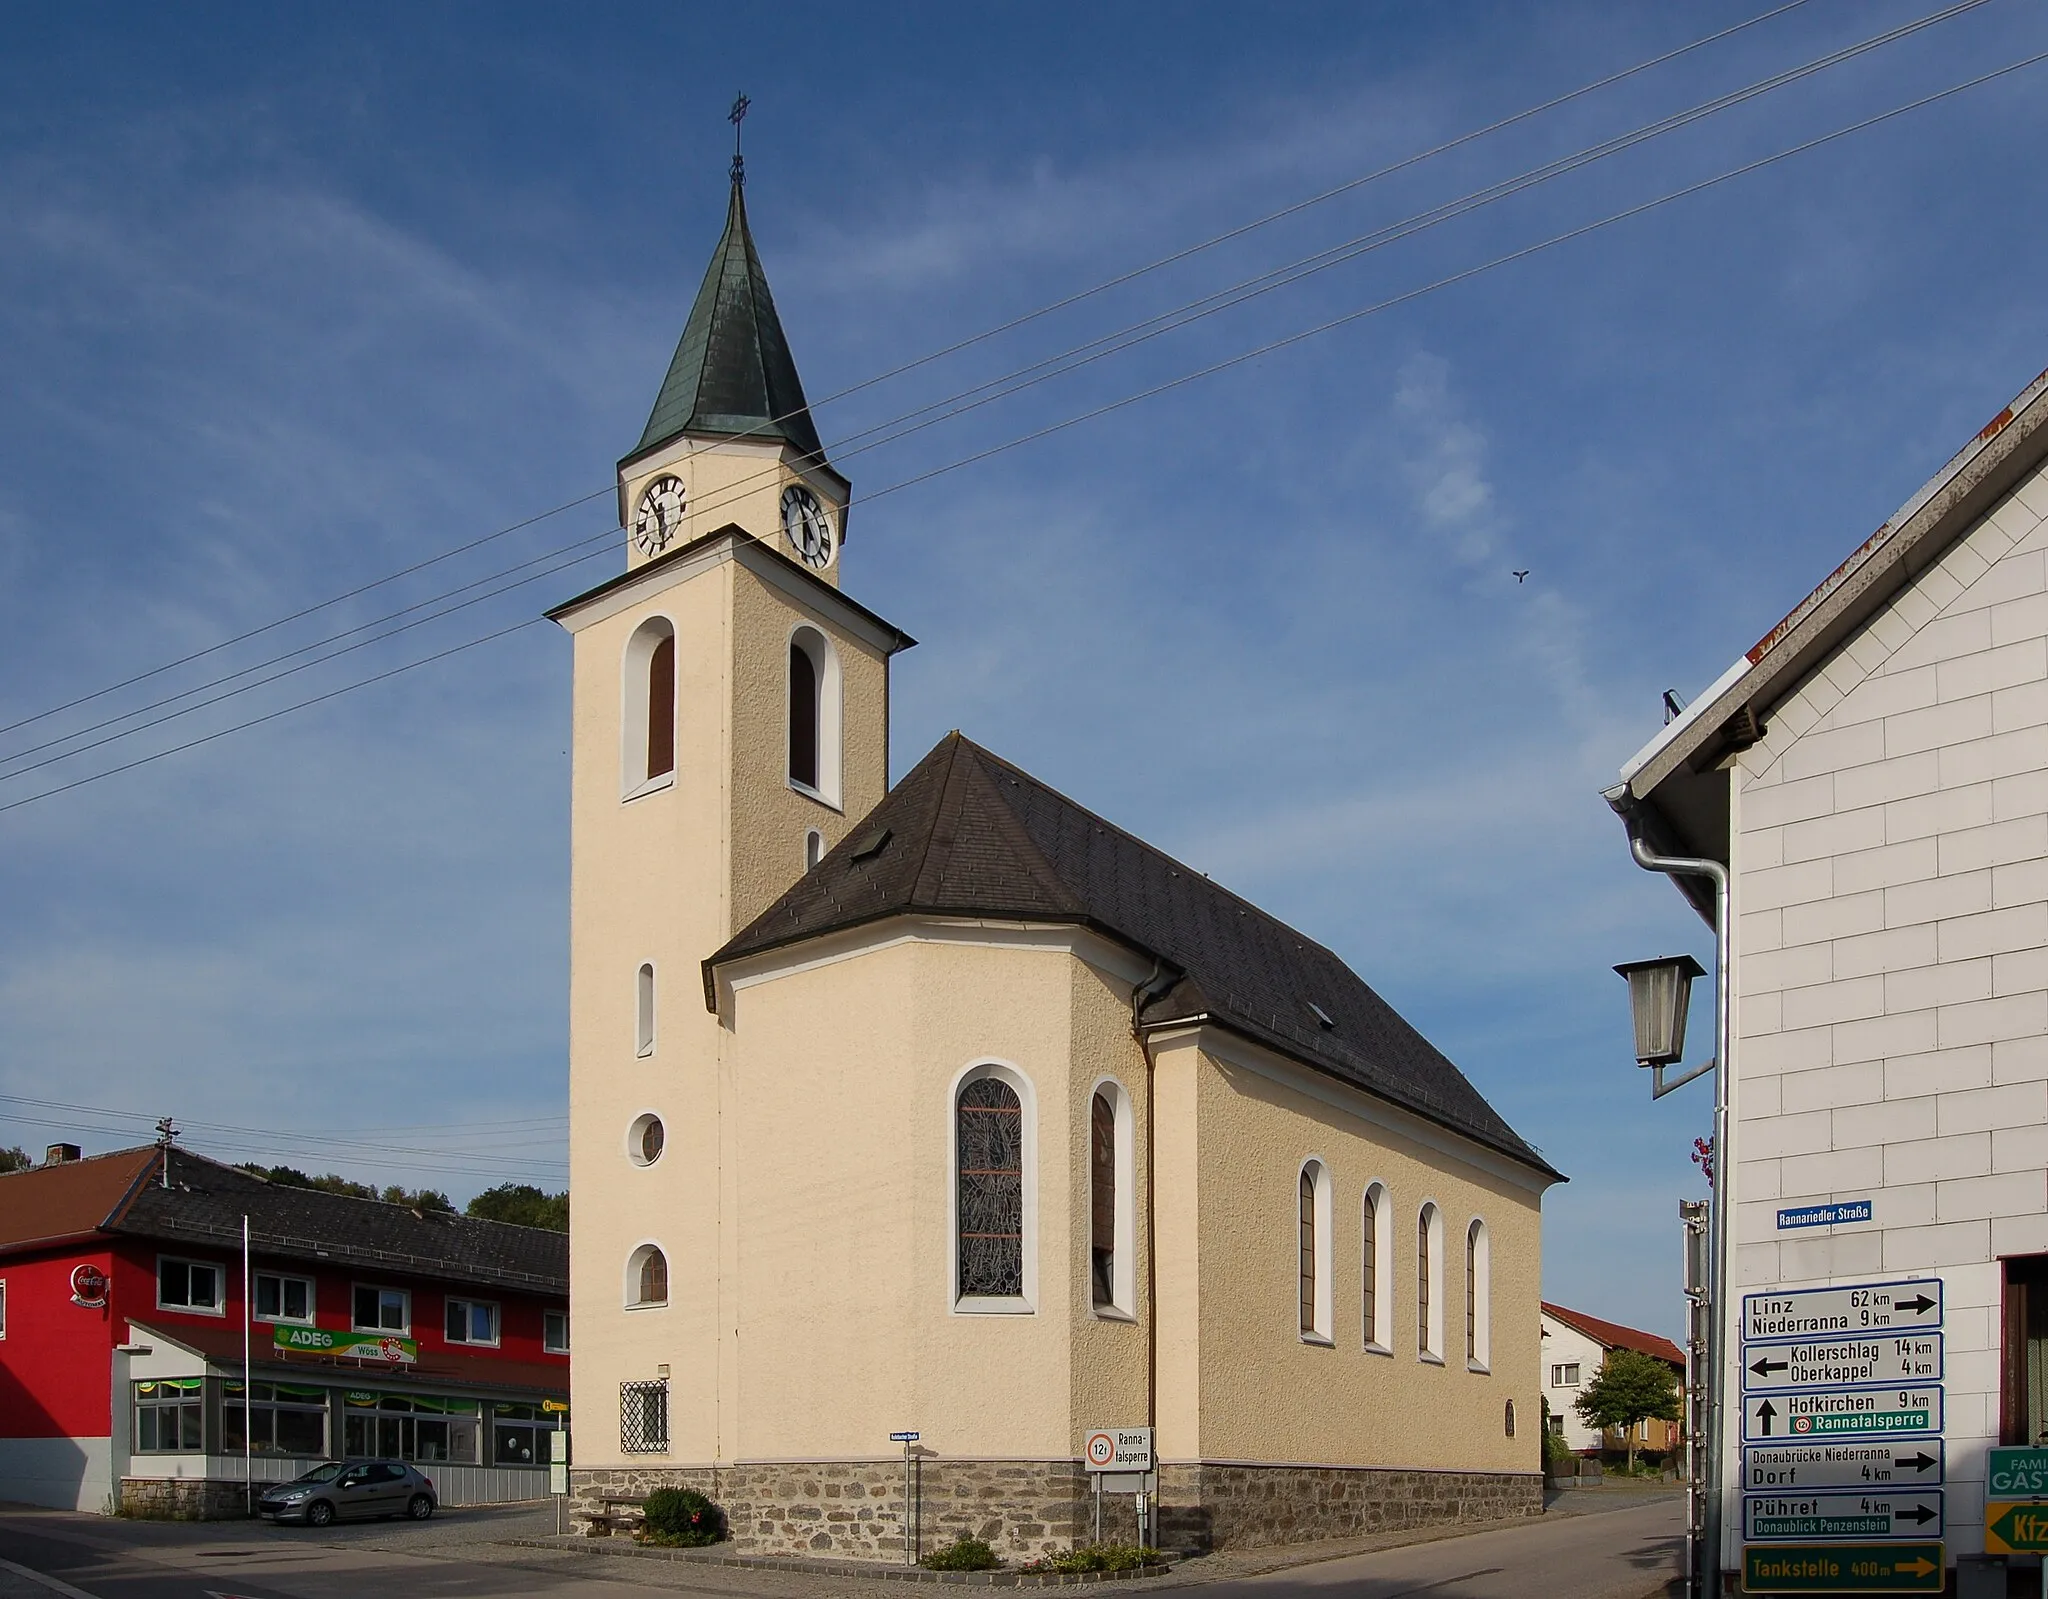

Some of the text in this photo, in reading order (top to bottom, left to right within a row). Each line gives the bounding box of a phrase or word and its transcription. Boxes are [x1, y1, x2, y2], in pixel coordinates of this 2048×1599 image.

[1779, 1206, 1868, 1226] Rannariedler Straße
[1753, 1290, 1890, 1315] Linz 62 km
[1752, 1309, 1890, 1335] Niederranna 9 km
[290, 1330, 332, 1347] ADEG
[357, 1346, 378, 1356] Wöss
[1791, 1339, 1932, 1363] Kollerschlag 14 km
[1791, 1358, 1932, 1382] Oberkappel 4 km
[350, 1391, 371, 1400] ADEG
[1789, 1391, 1929, 1414] Hofkirchen 9 km
[1816, 1413, 1924, 1430] Rannatalsperre
[1118, 1433, 1146, 1445] Ranna-
[1094, 1444, 1107, 1455] 12t
[1116, 1450, 1148, 1465] talsperre
[1753, 1447, 1890, 1464] Donaubrücke Niederranna
[1753, 1464, 1891, 1484] Dorf 4 km
[1753, 1497, 1890, 1516] Pühret 4 km
[1756, 1518, 1887, 1533] Donaublick Penzenstein
[2014, 1514, 2048, 1541] Kfz
[1753, 1558, 1891, 1577] Tankstelle 400 m
